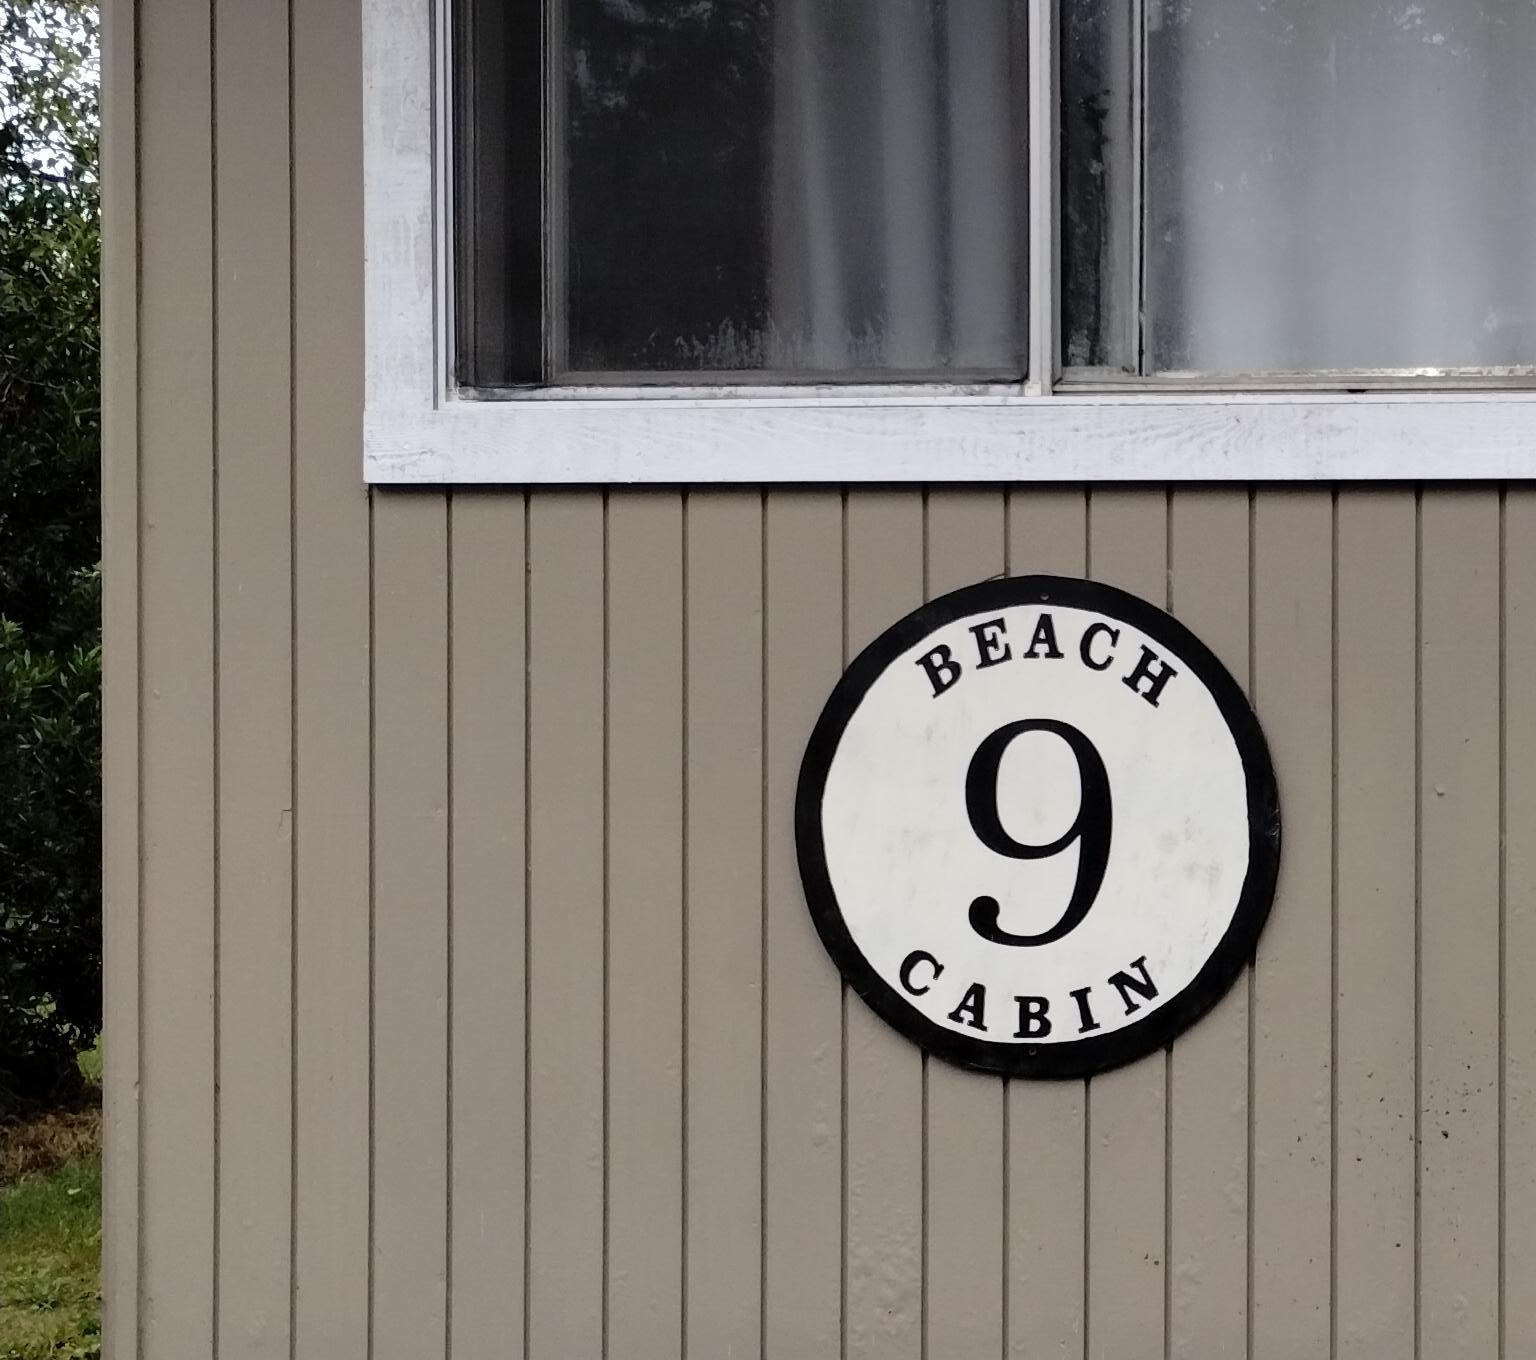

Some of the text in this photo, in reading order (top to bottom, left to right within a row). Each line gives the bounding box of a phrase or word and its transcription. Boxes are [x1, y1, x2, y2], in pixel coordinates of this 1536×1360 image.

[915, 613, 1178, 707] BEACH
[965, 718, 1113, 947] 9
[899, 950, 1160, 1039] CABIN
